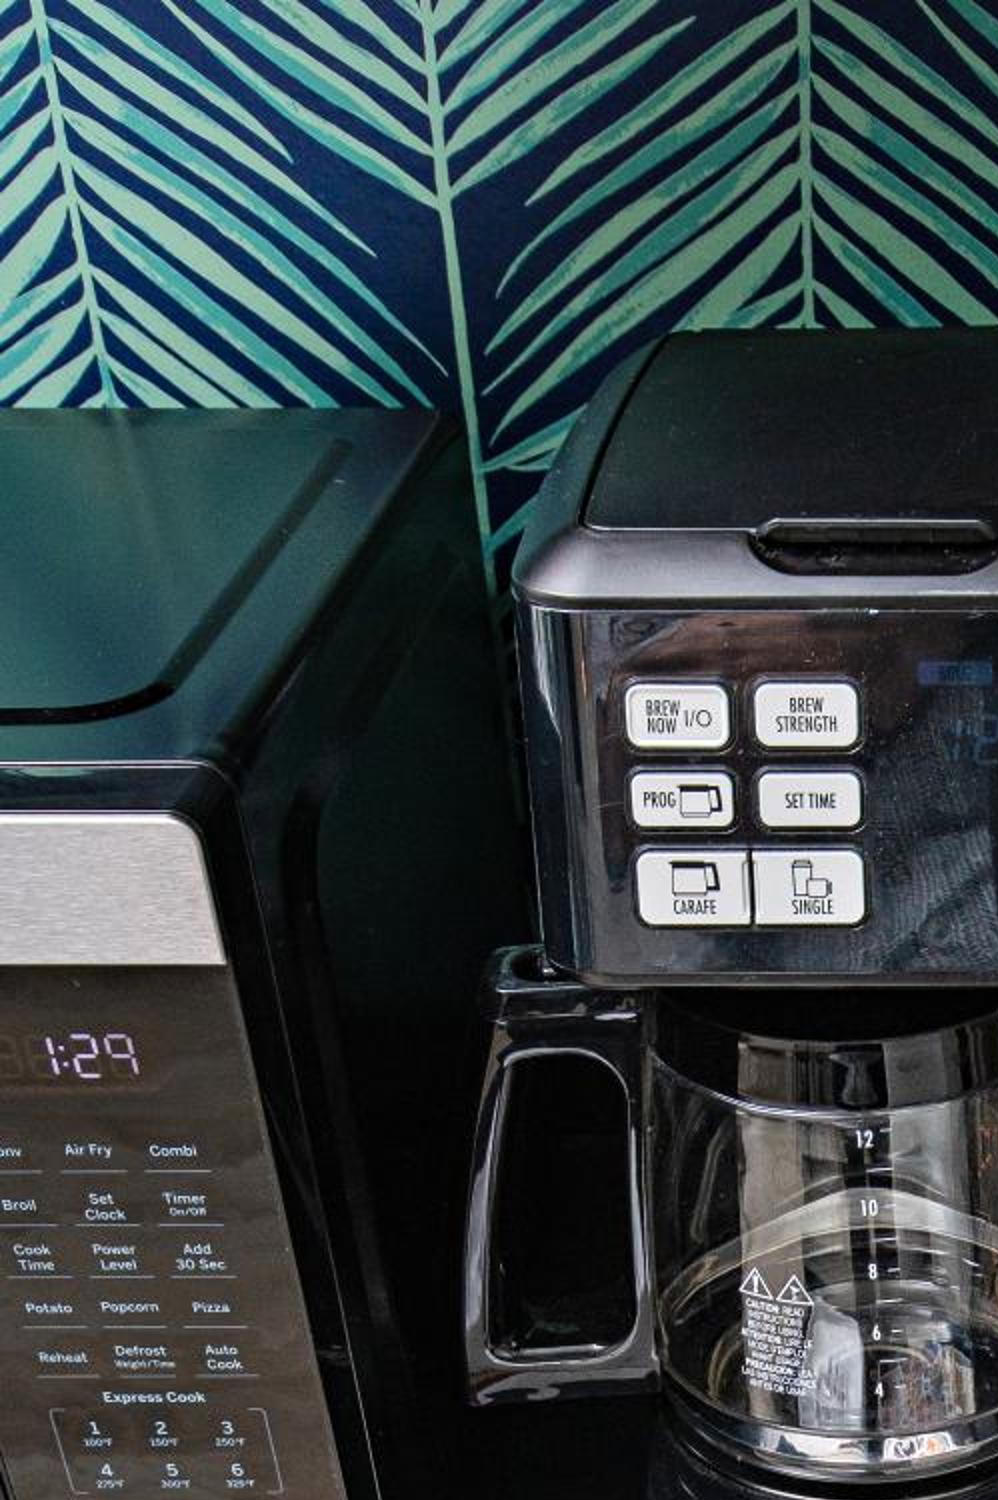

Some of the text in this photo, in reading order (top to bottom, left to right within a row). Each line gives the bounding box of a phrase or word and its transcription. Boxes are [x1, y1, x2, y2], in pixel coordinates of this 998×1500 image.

[645, 699, 681, 717] BREW
[789, 697, 825, 713] BREW
[647, 718, 678, 734] NOW
[775, 715, 838, 733] STRENGTH
[643, 791, 677, 809] PROG
[785, 793, 837, 809] SET TIME
[673, 899, 717, 915] CARAFE
[792, 899, 834, 915] SINGLE
[45, 1033, 140, 1079] 1:29
[854, 1130, 874, 1150] 12
[65, 1143, 112, 1158] Air Fry
[149, 1144, 197, 1157] Combi
[2, 1199, 37, 1211] Broil
[88, 1193, 114, 1205] Set
[162, 1192, 206, 1205] Timer
[85, 1208, 126, 1221] Clock
[860, 1199, 879, 1217] 10
[13, 1243, 51, 1256] Cook
[92, 1243, 136, 1256] Power
[183, 1243, 212, 1256] Add
[17, 1259, 55, 1271] Time
[100, 1259, 138, 1272] Level
[175, 1259, 226, 1271] 30 Sec
[868, 1263, 878, 1280] 8
[25, 1302, 73, 1314] Potato
[100, 1301, 160, 1314] Popcorn
[192, 1301, 231, 1313] Pizza
[872, 1324, 882, 1341] 6
[38, 1350, 88, 1364] Reheat
[114, 1345, 167, 1357] Defrost
[205, 1344, 239, 1356] Auto
[207, 1358, 244, 1371] Cook
[102, 1391, 206, 1404] Express Cook
[874, 1383, 884, 1399] 4
[88, 1421, 100, 1435] 1
[154, 1421, 168, 1435] 2
[221, 1421, 234, 1435] 3
[101, 1463, 113, 1477] 4
[165, 1463, 179, 1477] 5
[231, 1463, 244, 1477] 6
